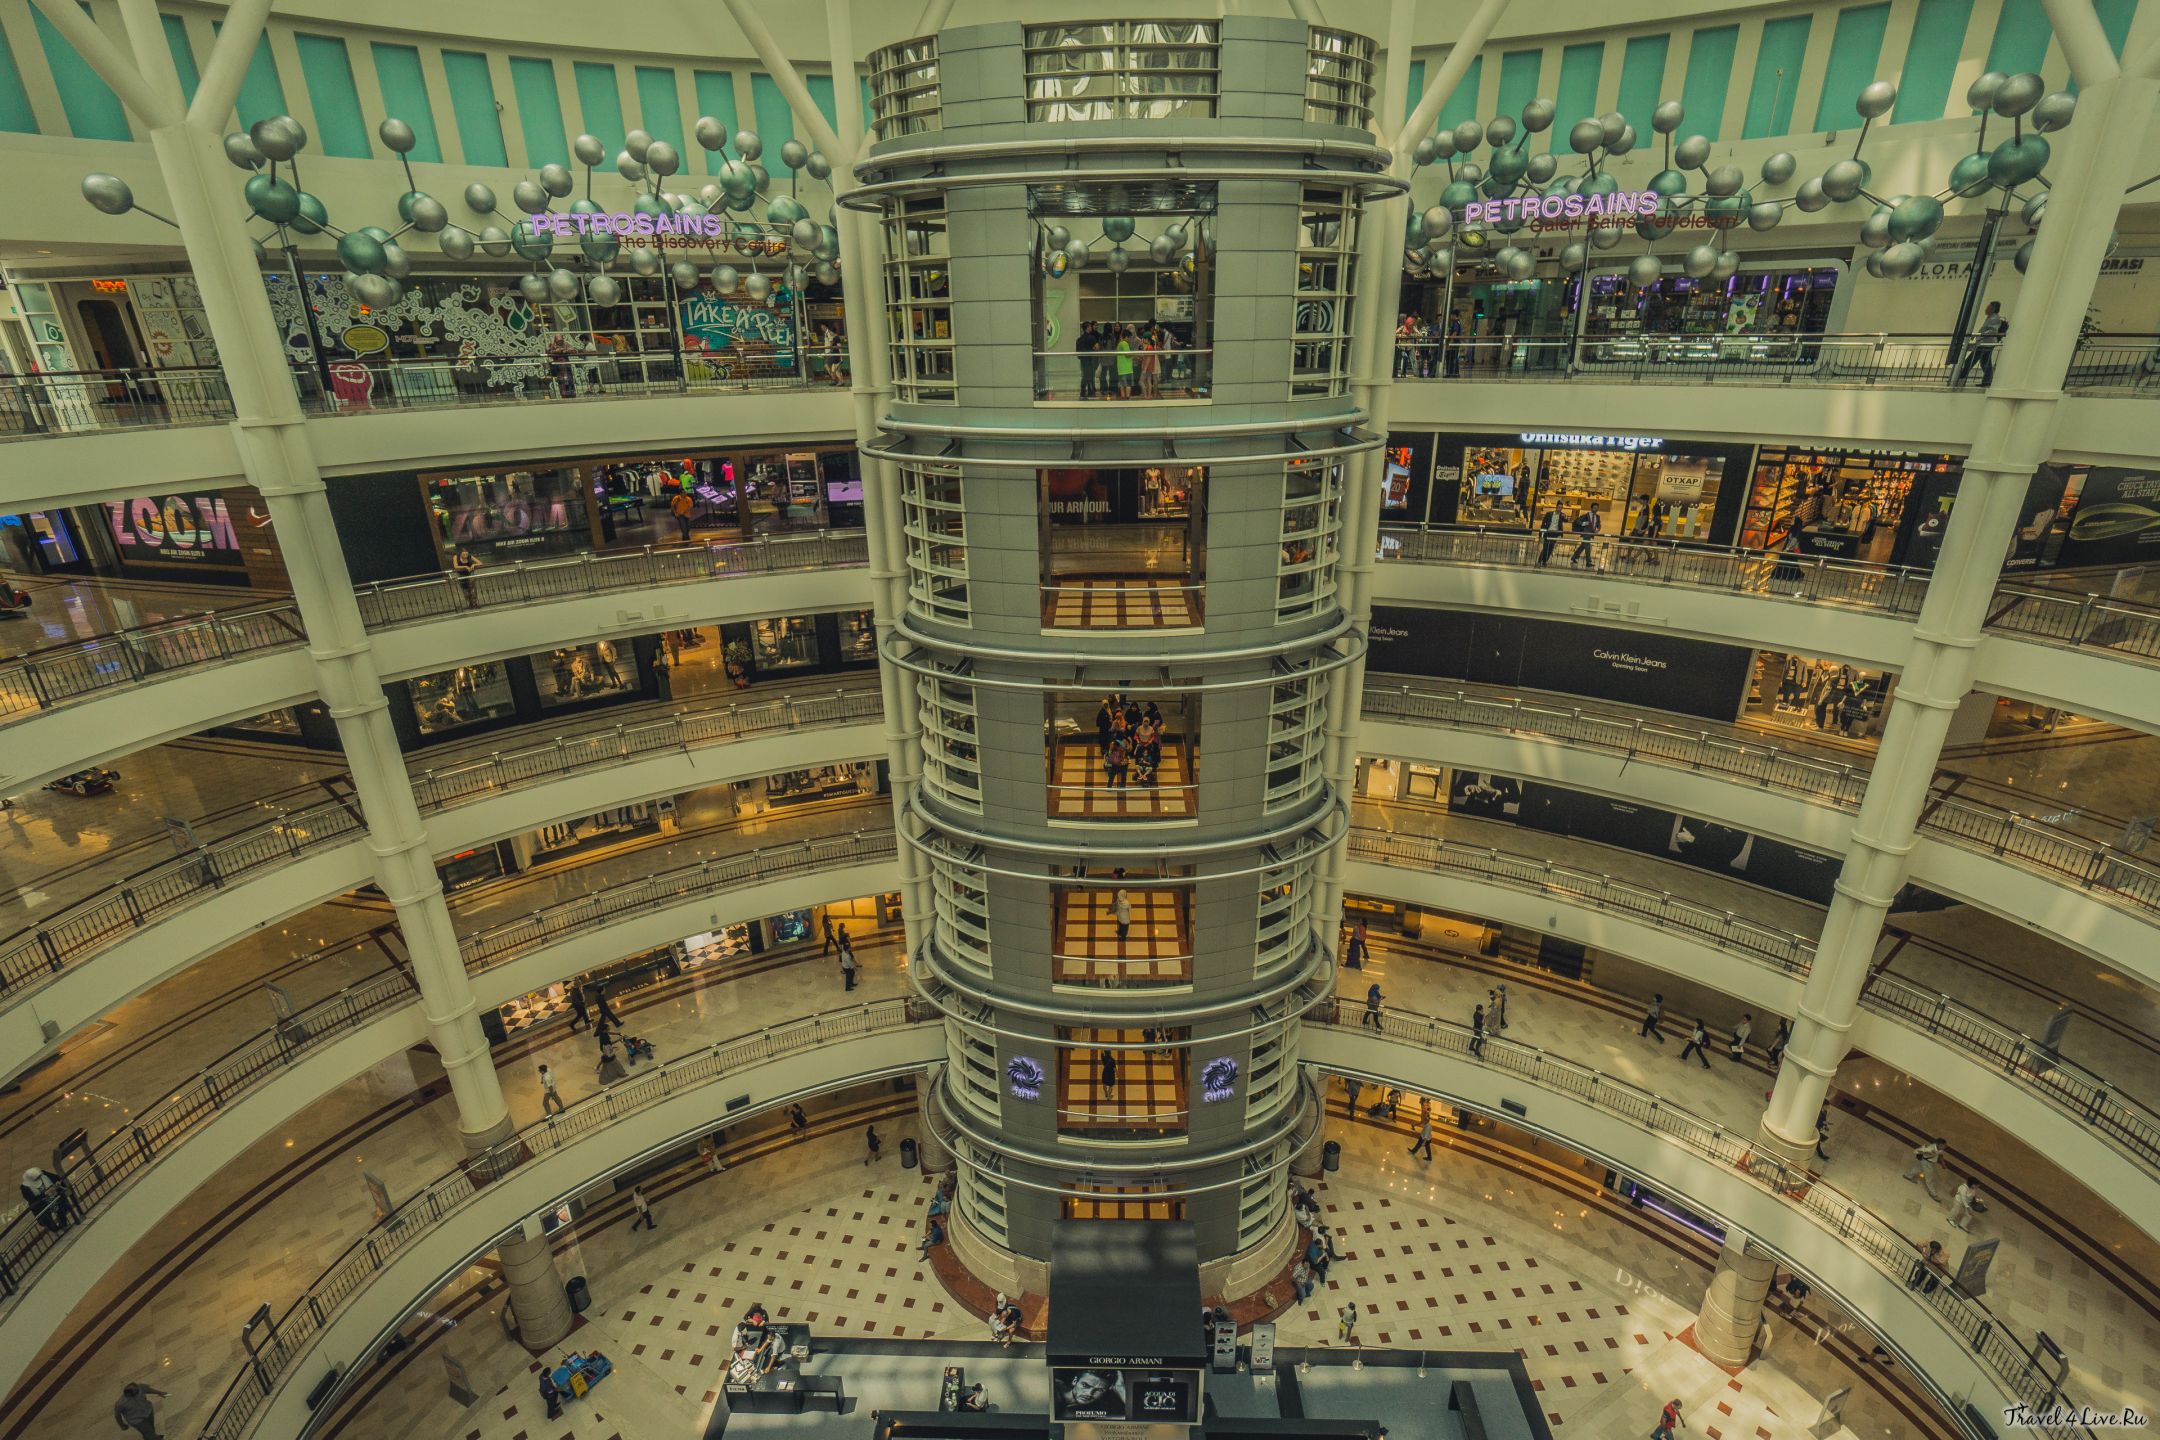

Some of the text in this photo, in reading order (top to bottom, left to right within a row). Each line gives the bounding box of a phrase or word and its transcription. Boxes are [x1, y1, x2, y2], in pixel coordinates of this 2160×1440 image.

[1465, 190, 1659, 225] PETROSAINS
[1587, 214, 1636, 230] Sains
[615, 234, 647, 249] The
[652, 235, 731, 253] Discovery
[679, 297, 734, 326] TAKE
[104, 495, 241, 550] ZOOM
[1593, 649, 1668, 669] Calvin Klein Jeans
[1089, 1357, 1163, 1366] GIORGIO ARMANI
